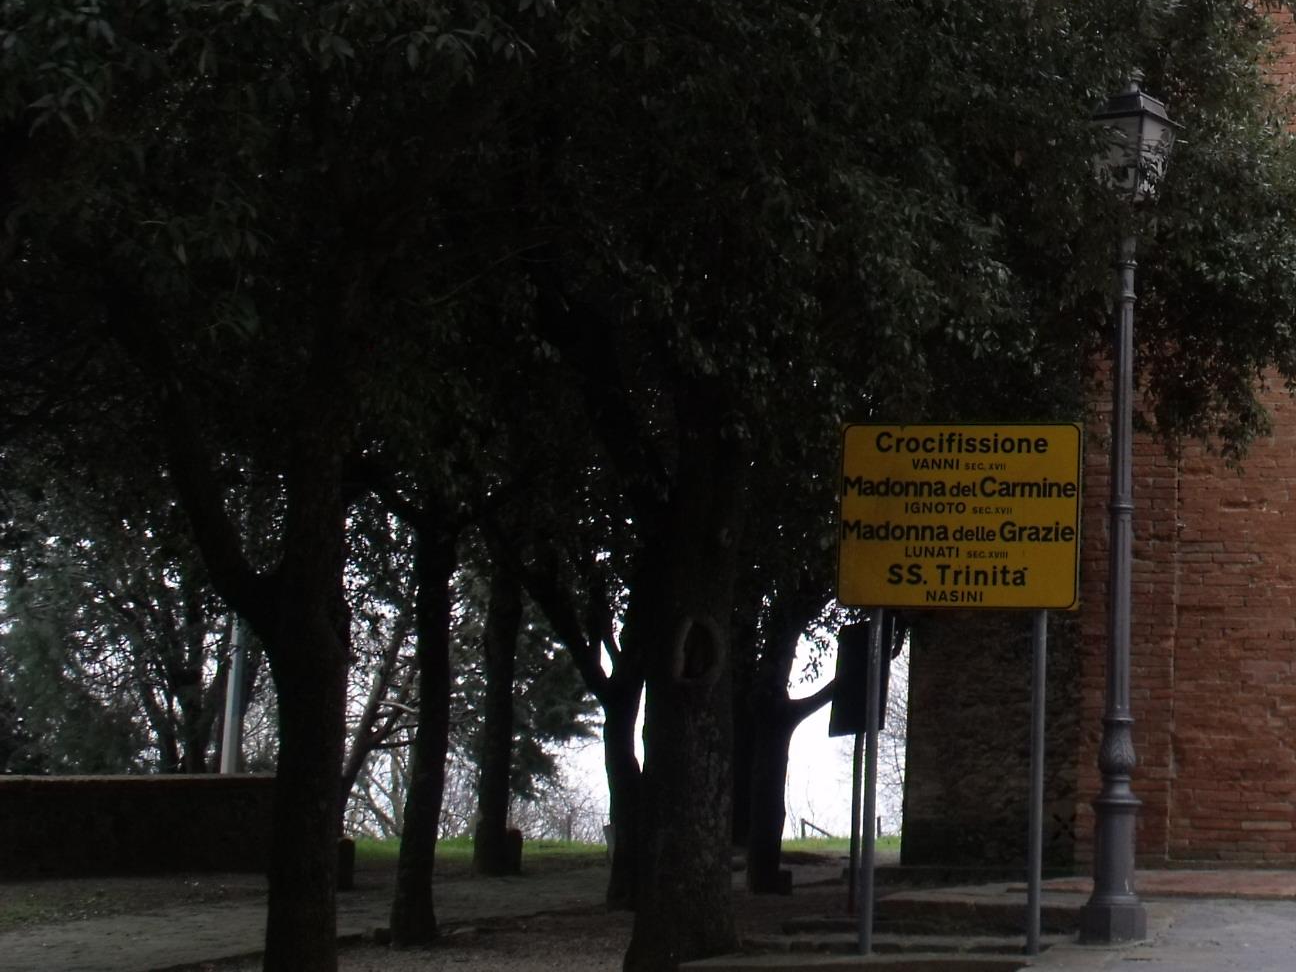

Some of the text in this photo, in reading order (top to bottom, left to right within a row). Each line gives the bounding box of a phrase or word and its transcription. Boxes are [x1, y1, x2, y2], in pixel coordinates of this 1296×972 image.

[876, 432, 1048, 454] Crocifissione
[911, 458, 960, 470] VANNI
[843, 476, 1076, 498] Madonna del Carmine
[904, 502, 966, 514] IGNOTO
[842, 520, 1075, 542] Madonna delle Grazie
[904, 546, 960, 559] LUNATI
[887, 563, 928, 586] SS.
[925, 590, 984, 603] NASINI
